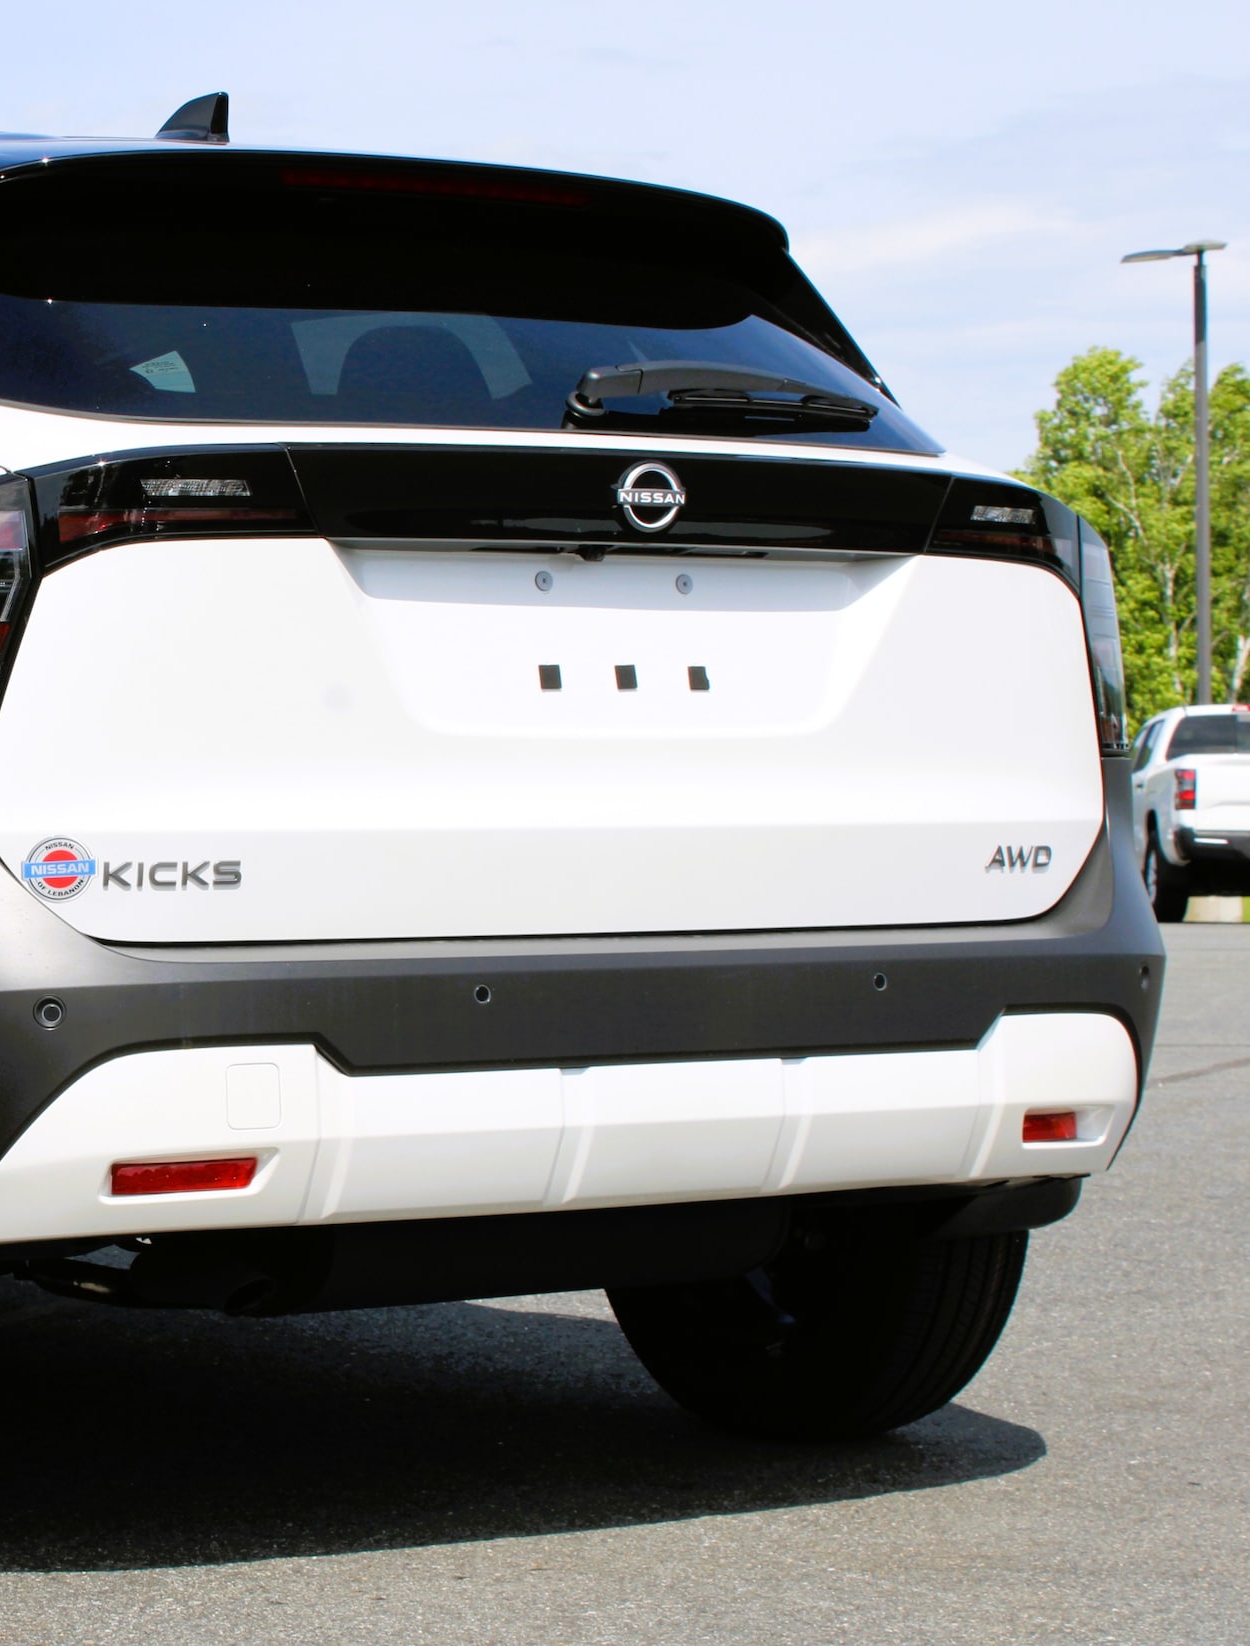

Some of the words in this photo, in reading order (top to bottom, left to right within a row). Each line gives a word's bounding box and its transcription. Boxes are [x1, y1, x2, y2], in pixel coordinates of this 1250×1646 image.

[619, 491, 685, 505] NISSAN
[45, 841, 75, 850] NISSAN
[984, 844, 1053, 871] AWD
[30, 862, 90, 876] NISSAN
[102, 860, 242, 890] KICKS
[47, 879, 85, 897] LEBANON
